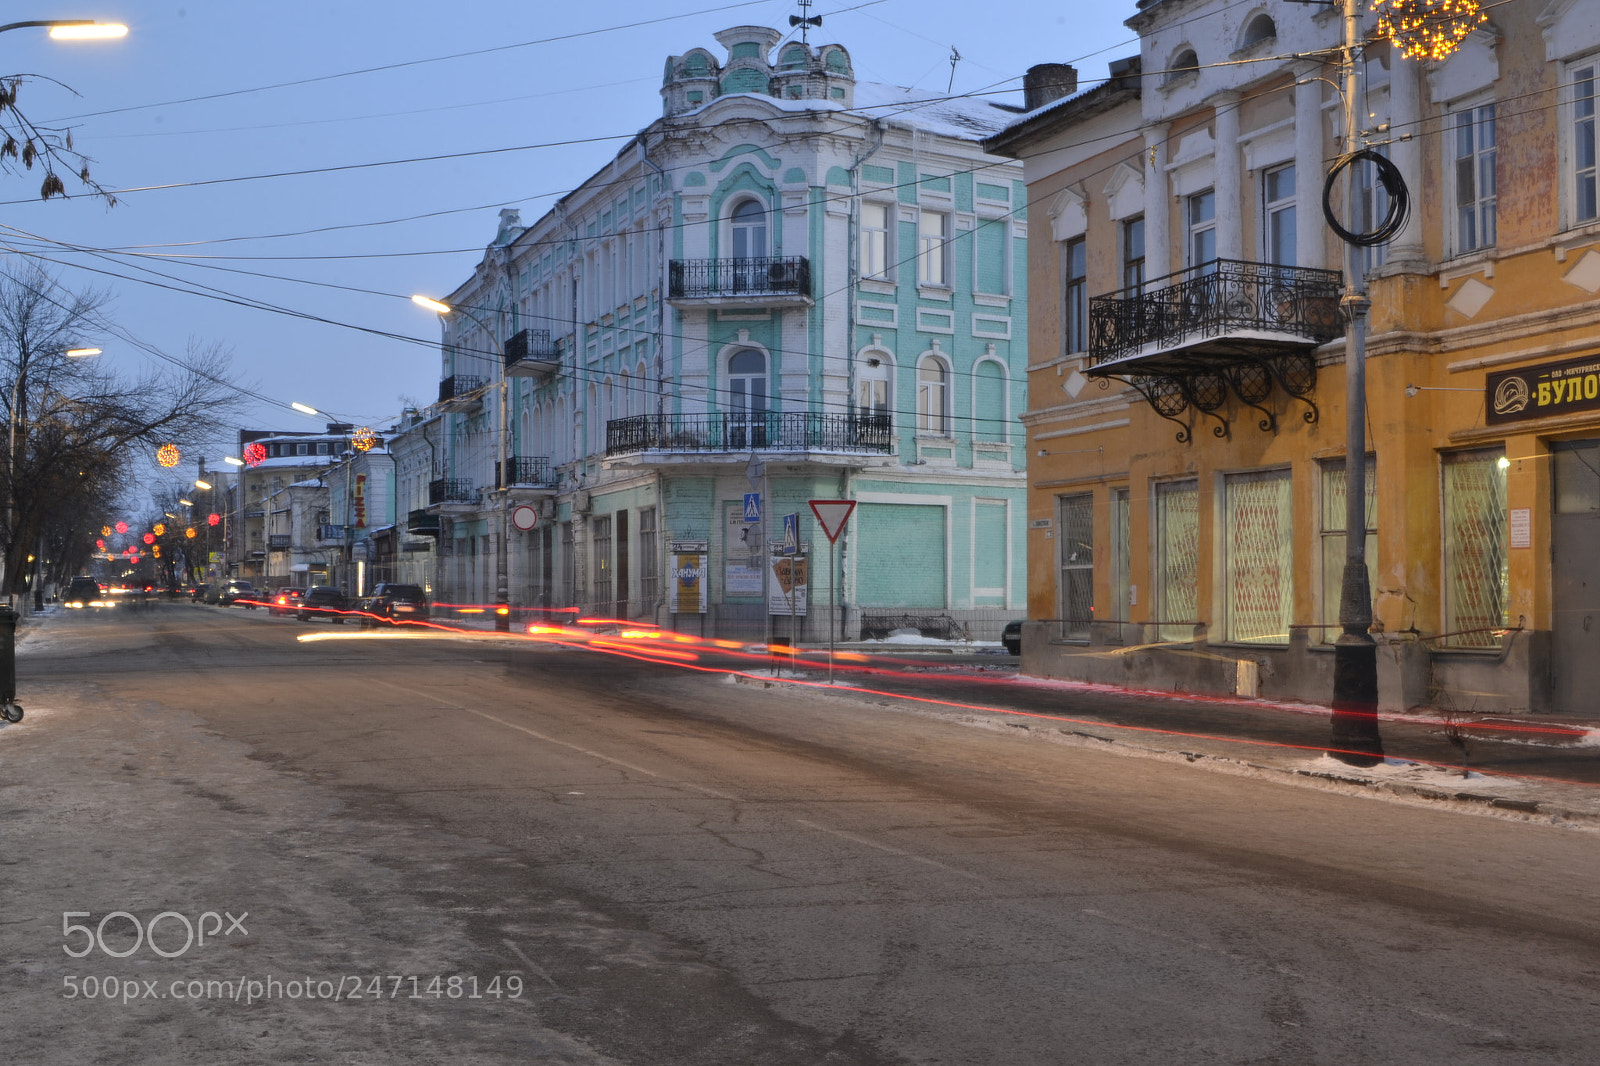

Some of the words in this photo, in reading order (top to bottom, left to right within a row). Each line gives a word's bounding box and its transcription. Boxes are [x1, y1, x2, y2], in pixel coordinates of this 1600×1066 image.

[1538, 374, 1600, 406] БУЛО
[355, 474, 366, 528] PIZZA
[672, 568, 706, 578] ХАНУМА
